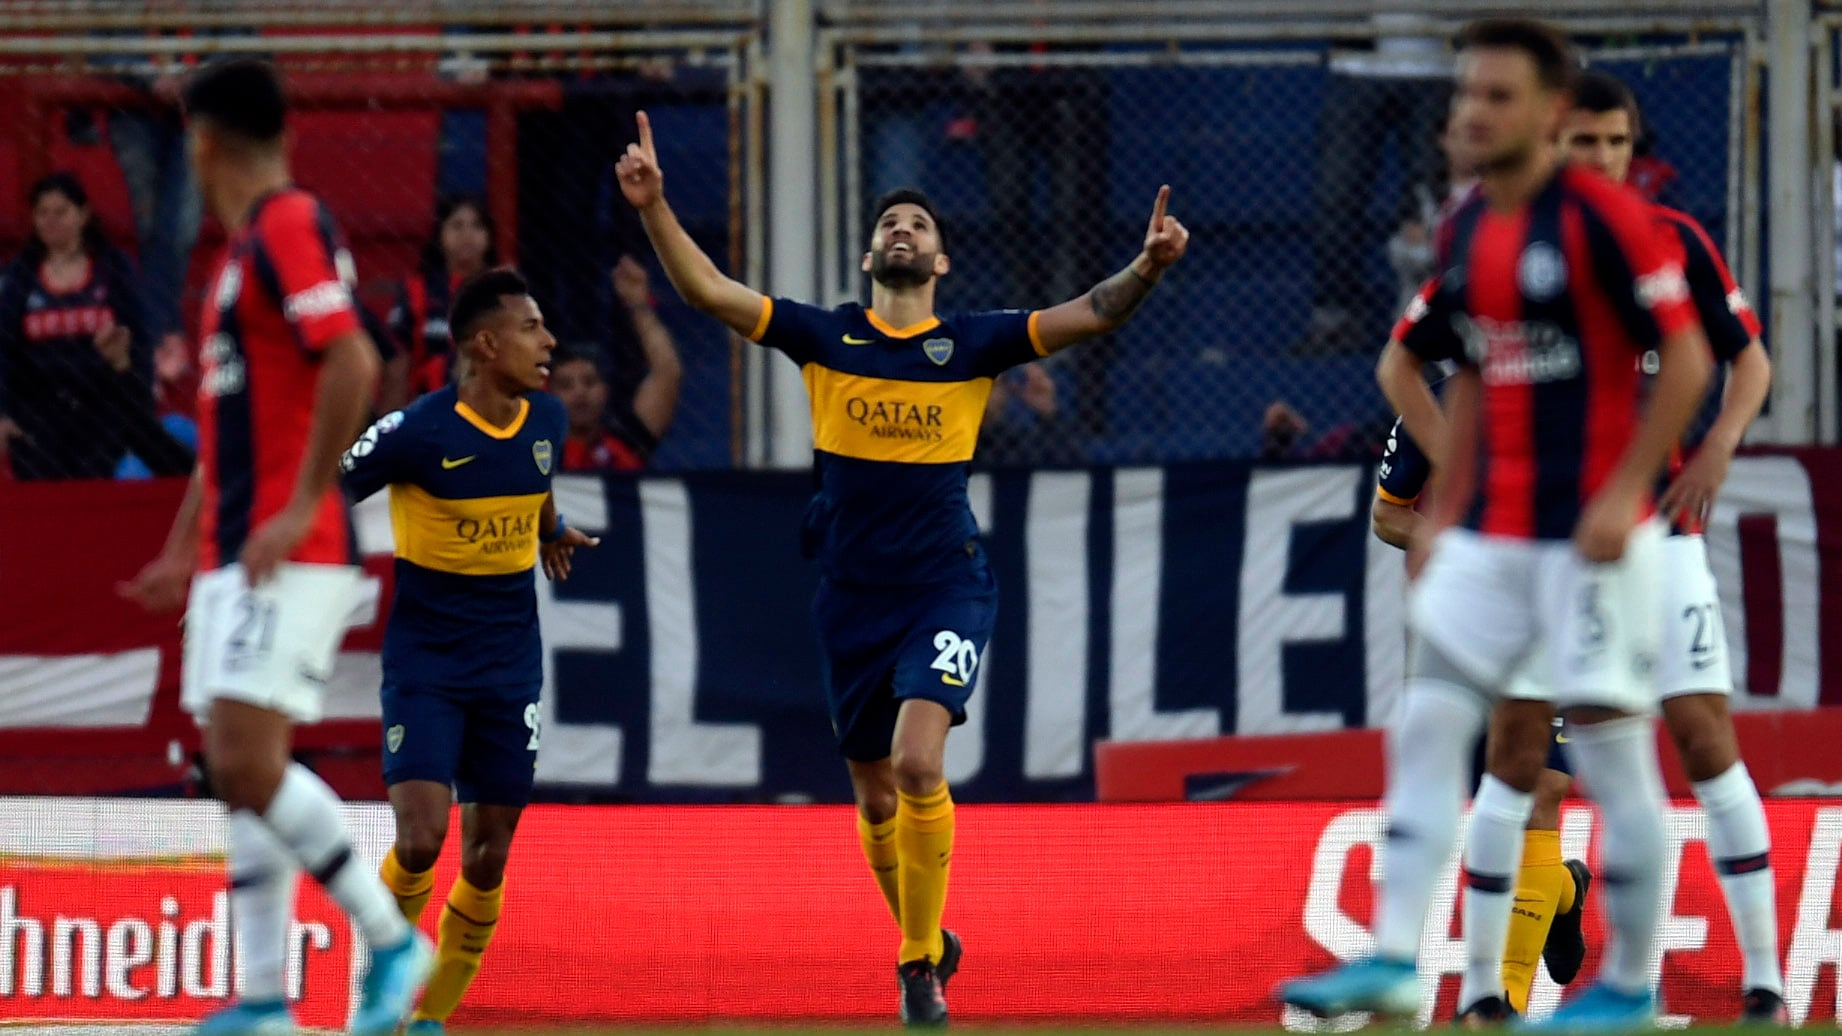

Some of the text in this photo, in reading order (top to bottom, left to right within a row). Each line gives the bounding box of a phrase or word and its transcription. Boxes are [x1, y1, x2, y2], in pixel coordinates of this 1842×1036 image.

[846, 397, 943, 427] QATAR
[869, 426, 943, 442] AIRWAYS
[457, 515, 535, 542] QATAR
[538, 480, 762, 786] EL
[930, 630, 978, 684] 20
[0, 885, 331, 1001] hneidr
